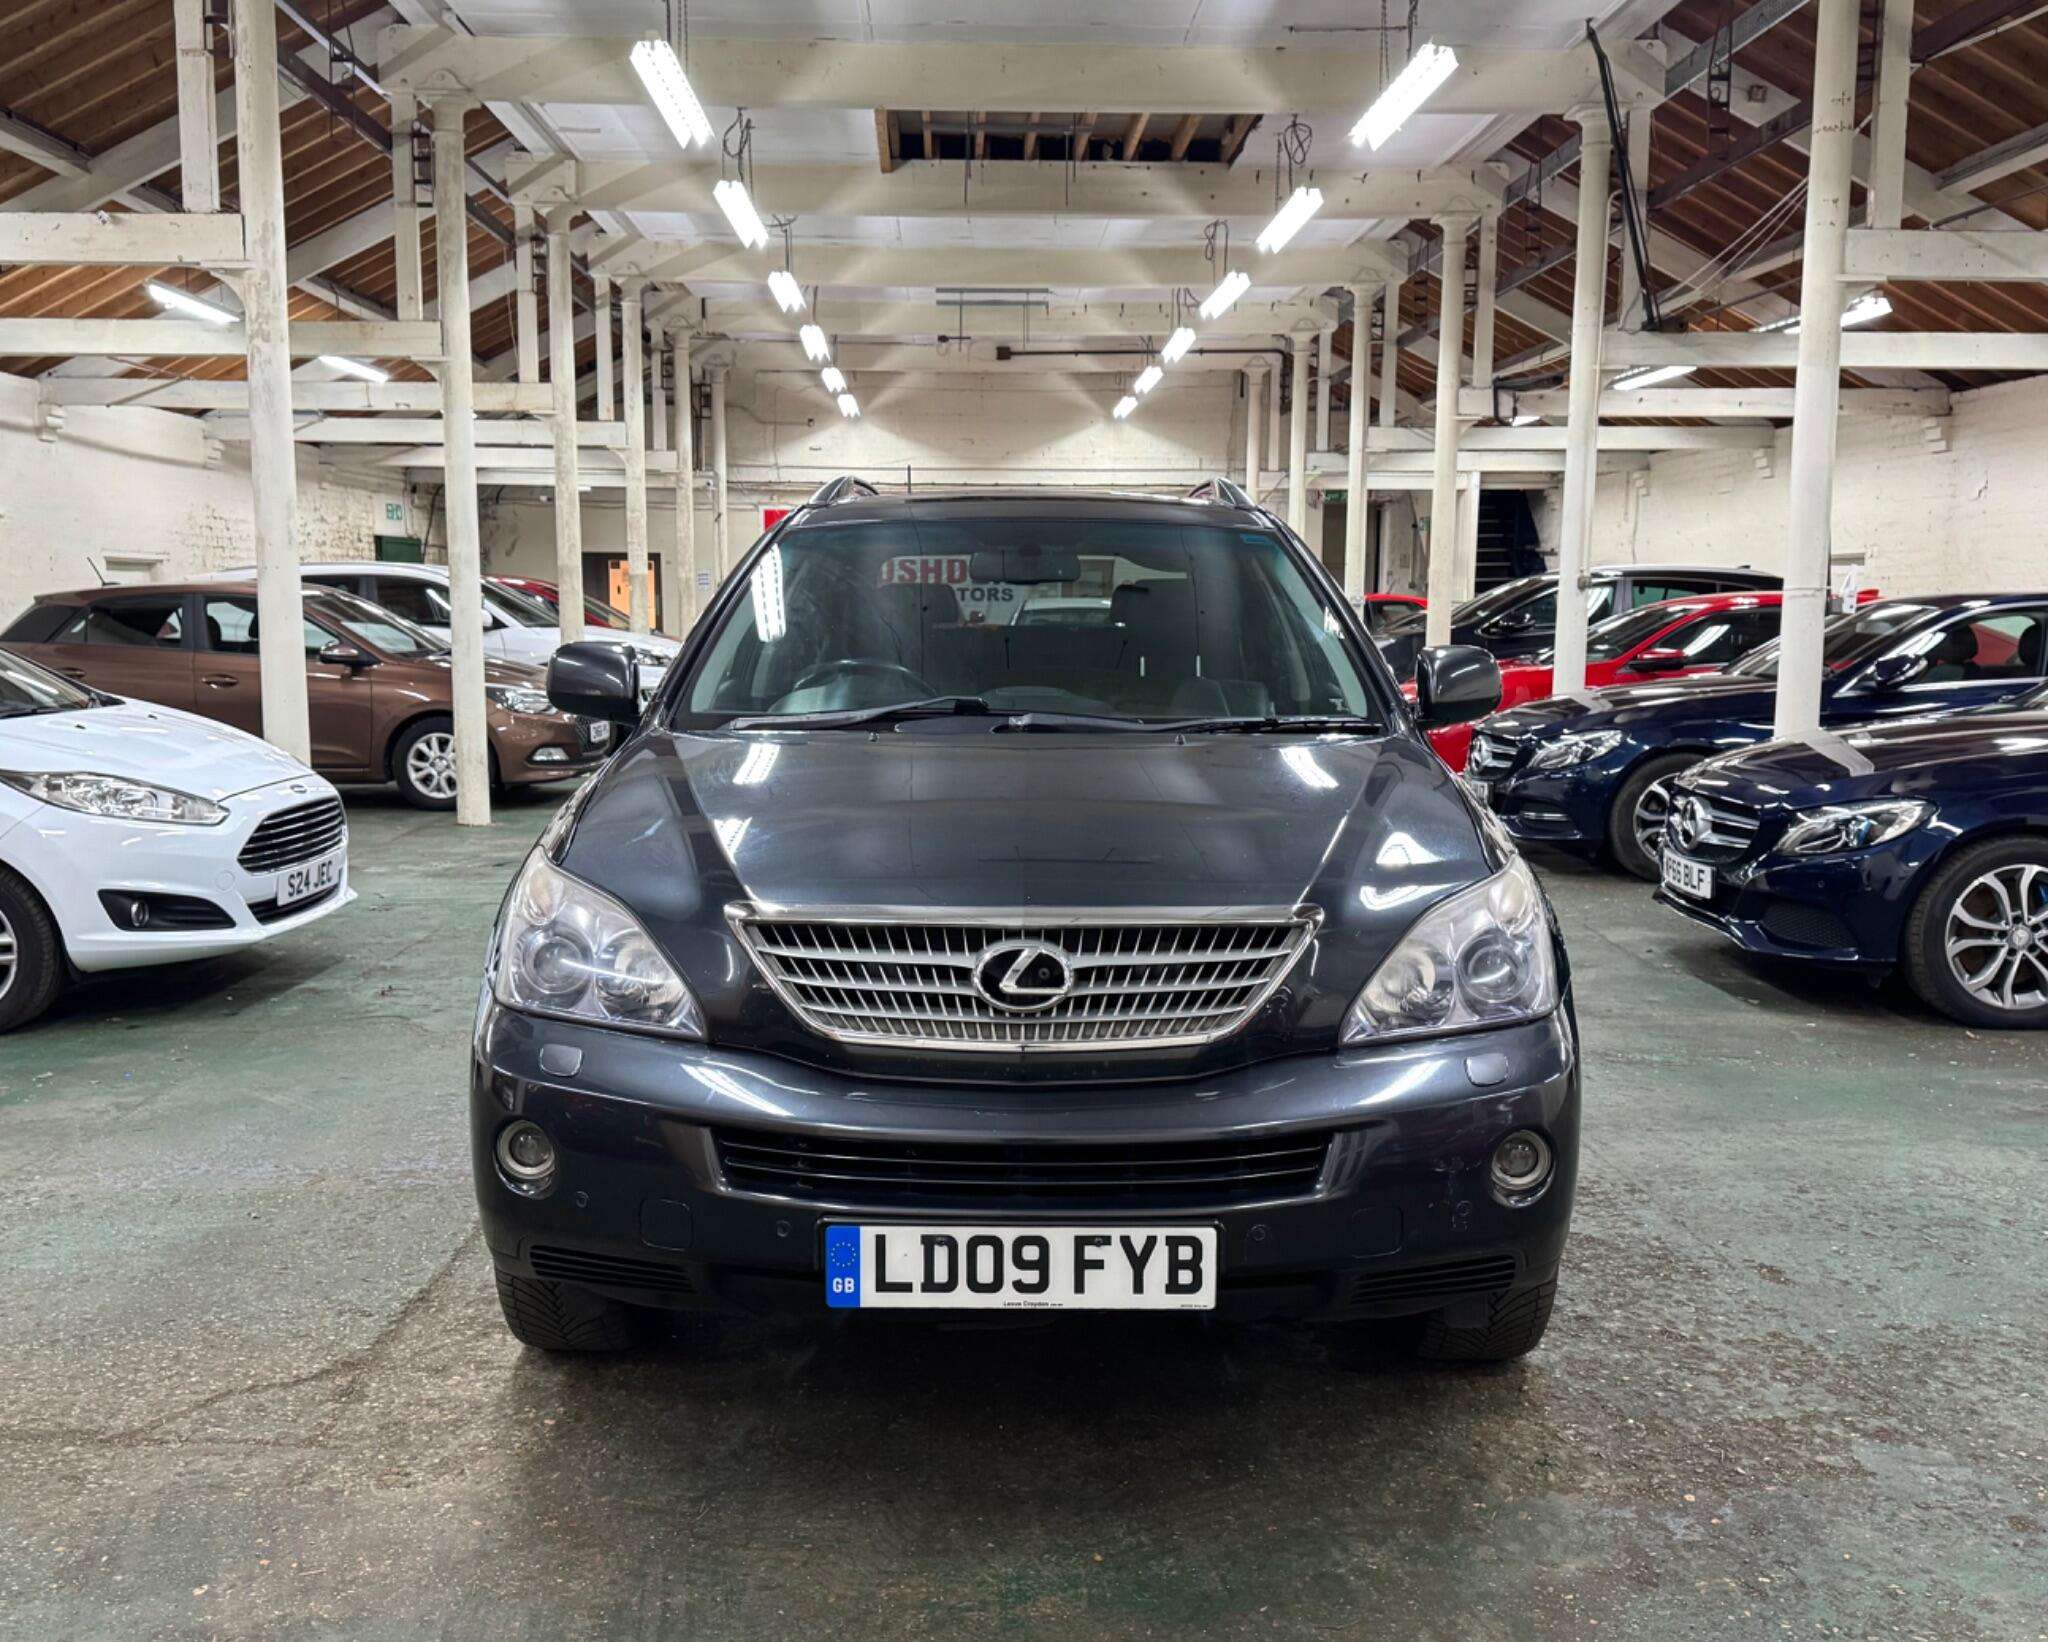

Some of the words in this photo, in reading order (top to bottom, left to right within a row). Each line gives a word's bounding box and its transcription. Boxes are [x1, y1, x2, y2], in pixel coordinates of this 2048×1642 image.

[288, 869, 310, 897] S24
[313, 860, 333, 888] JEC
[875, 1234, 1050, 1294] LD09
[1074, 1235, 1203, 1295] FYB
[832, 1277, 855, 1293] GB
